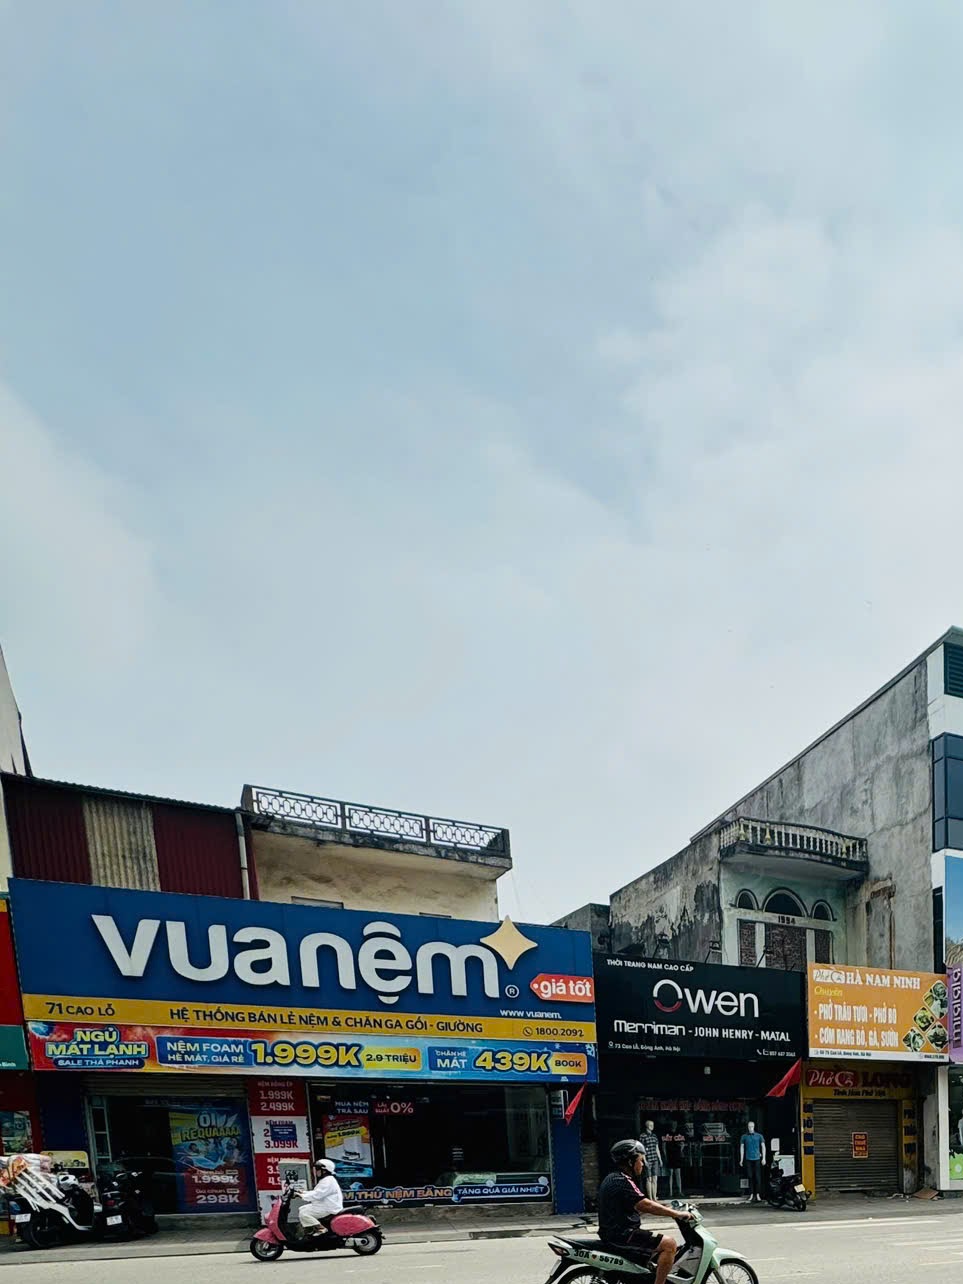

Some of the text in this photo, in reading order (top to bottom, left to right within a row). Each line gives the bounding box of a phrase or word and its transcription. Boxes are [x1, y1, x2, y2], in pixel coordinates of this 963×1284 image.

[624, 960, 646, 968] TRANG
[647, 962, 663, 970] NAM
[680, 964, 694, 972] CẤP
[846, 969, 863, 985] HÀ
[866, 973, 891, 987] NAM
[893, 975, 921, 990] NINH
[540, 976, 592, 999] giá tốt
[653, 979, 759, 1018] Owen
[45, 1002, 63, 1014] 71
[66, 1004, 94, 1016] CAO
[818, 998, 834, 1020] PHỞ
[169, 1006, 483, 1033] HỆ THỐNG BÁN LẺ NỆM & CHĂN GA GỐI GIƯỜNG
[76, 1026, 118, 1042] NGỦ
[536, 1027, 585, 1037] 1800.2092
[613, 1019, 791, 1042] Merriman JOHN HENRY MATAL
[47, 1041, 147, 1059] MÁT LẠNH
[166, 1041, 244, 1055] NỆM FOAM
[251, 1042, 360, 1066] 1.999K
[57, 1057, 139, 1067] SALE THẢ PHANH
[211, 1053, 230, 1062] GIÁ
[386, 1053, 417, 1065] TRIỆU
[436, 1056, 468, 1069] MÁT
[475, 1051, 550, 1072] 439K
[808, 1069, 834, 1086] Phở
[259, 1090, 294, 1100] 1.999K
[260, 1102, 295, 1112] 2.499K
[390, 1102, 414, 1114] 0%
[264, 1140, 299, 1149] 3.099K
[192, 1175, 241, 1184] 1.999K
[196, 1194, 240, 1204] 298K
[356, 1188, 383, 1200] THỬ
[385, 1189, 415, 1201] NỆM
[457, 1187, 482, 1196] TẶNG
[520, 1185, 544, 1194] NHIỆT
[574, 1249, 624, 1266] 30A 56789
